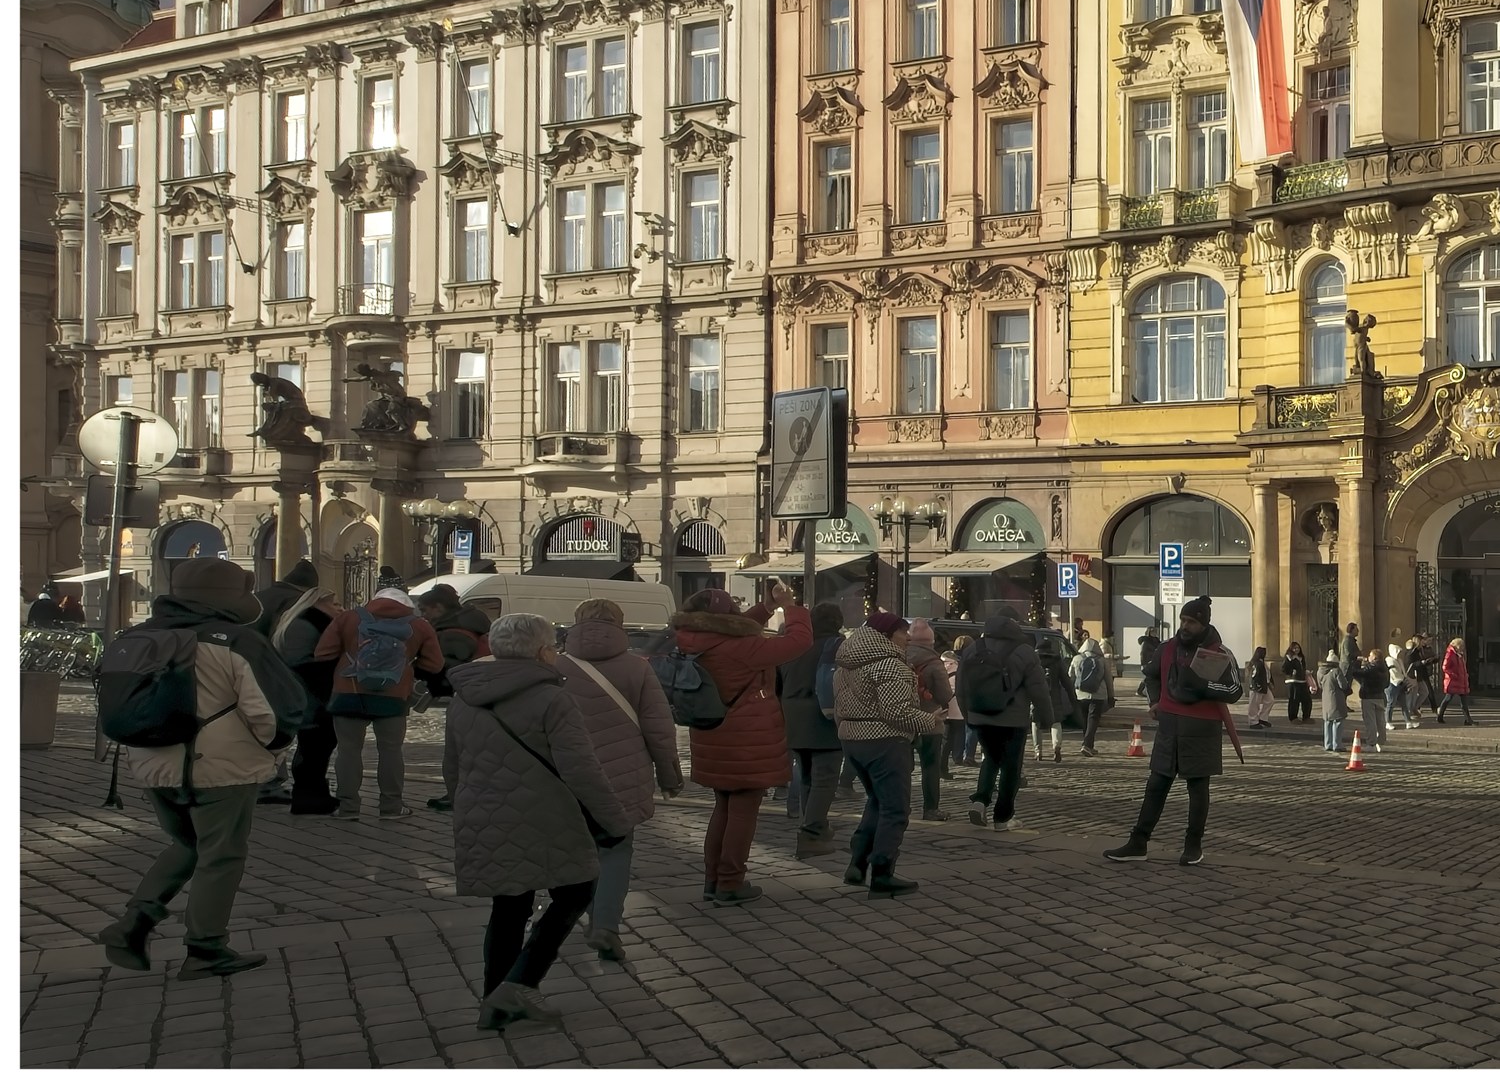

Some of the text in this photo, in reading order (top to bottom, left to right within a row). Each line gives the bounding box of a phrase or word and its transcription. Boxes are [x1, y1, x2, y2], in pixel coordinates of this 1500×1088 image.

[815, 530, 861, 544] OMEGA
[975, 529, 1026, 543] OMEGA
[567, 539, 609, 551] TUDOR
[1164, 547, 1178, 567] P
[1062, 567, 1073, 587] P
